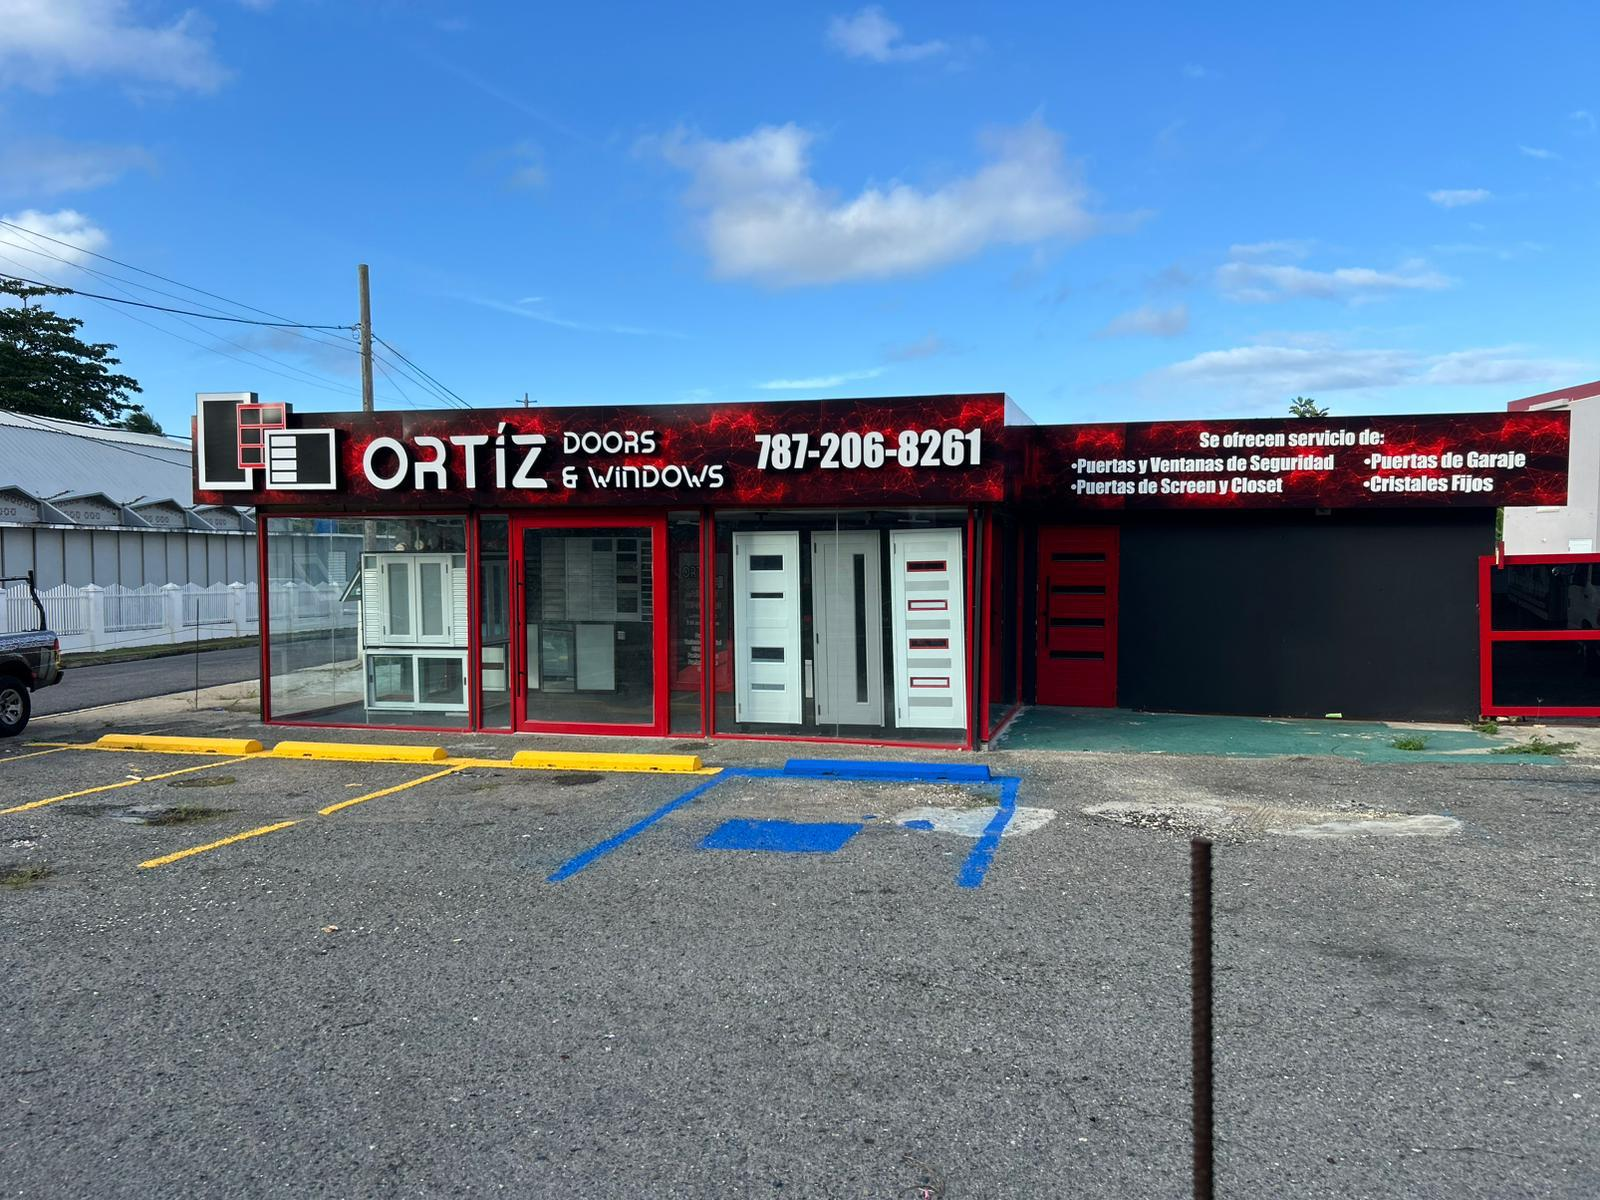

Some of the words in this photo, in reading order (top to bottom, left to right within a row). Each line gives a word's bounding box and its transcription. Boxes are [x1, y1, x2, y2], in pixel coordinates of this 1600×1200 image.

[563, 430, 656, 454] DOORS
[754, 427, 981, 470] 787-206-8261
[1199, 431, 1220, 448] Se
[1222, 431, 1286, 448] ofrecen
[1287, 429, 1356, 447] servicio
[1358, 428, 1385, 446] de:
[362, 421, 548, 490] ORTÍZ
[1077, 458, 1136, 474] Puertas
[1138, 459, 1148, 475] y
[1149, 456, 1225, 473] Ventanas
[1226, 455, 1248, 472] de
[1249, 454, 1335, 473] Seguridad
[1370, 453, 1438, 470] Puertas
[1440, 451, 1464, 469] de
[1466, 450, 1526, 470] Garaje
[561, 465, 579, 489] &
[1076, 479, 1136, 495] Puertas
[1138, 478, 1158, 495] de
[1160, 477, 1217, 494] Screen
[1218, 479, 1229, 495] y
[1230, 476, 1284, 494] Closet
[1370, 475, 1449, 493] Cristales
[1451, 474, 1494, 494] Fijos
